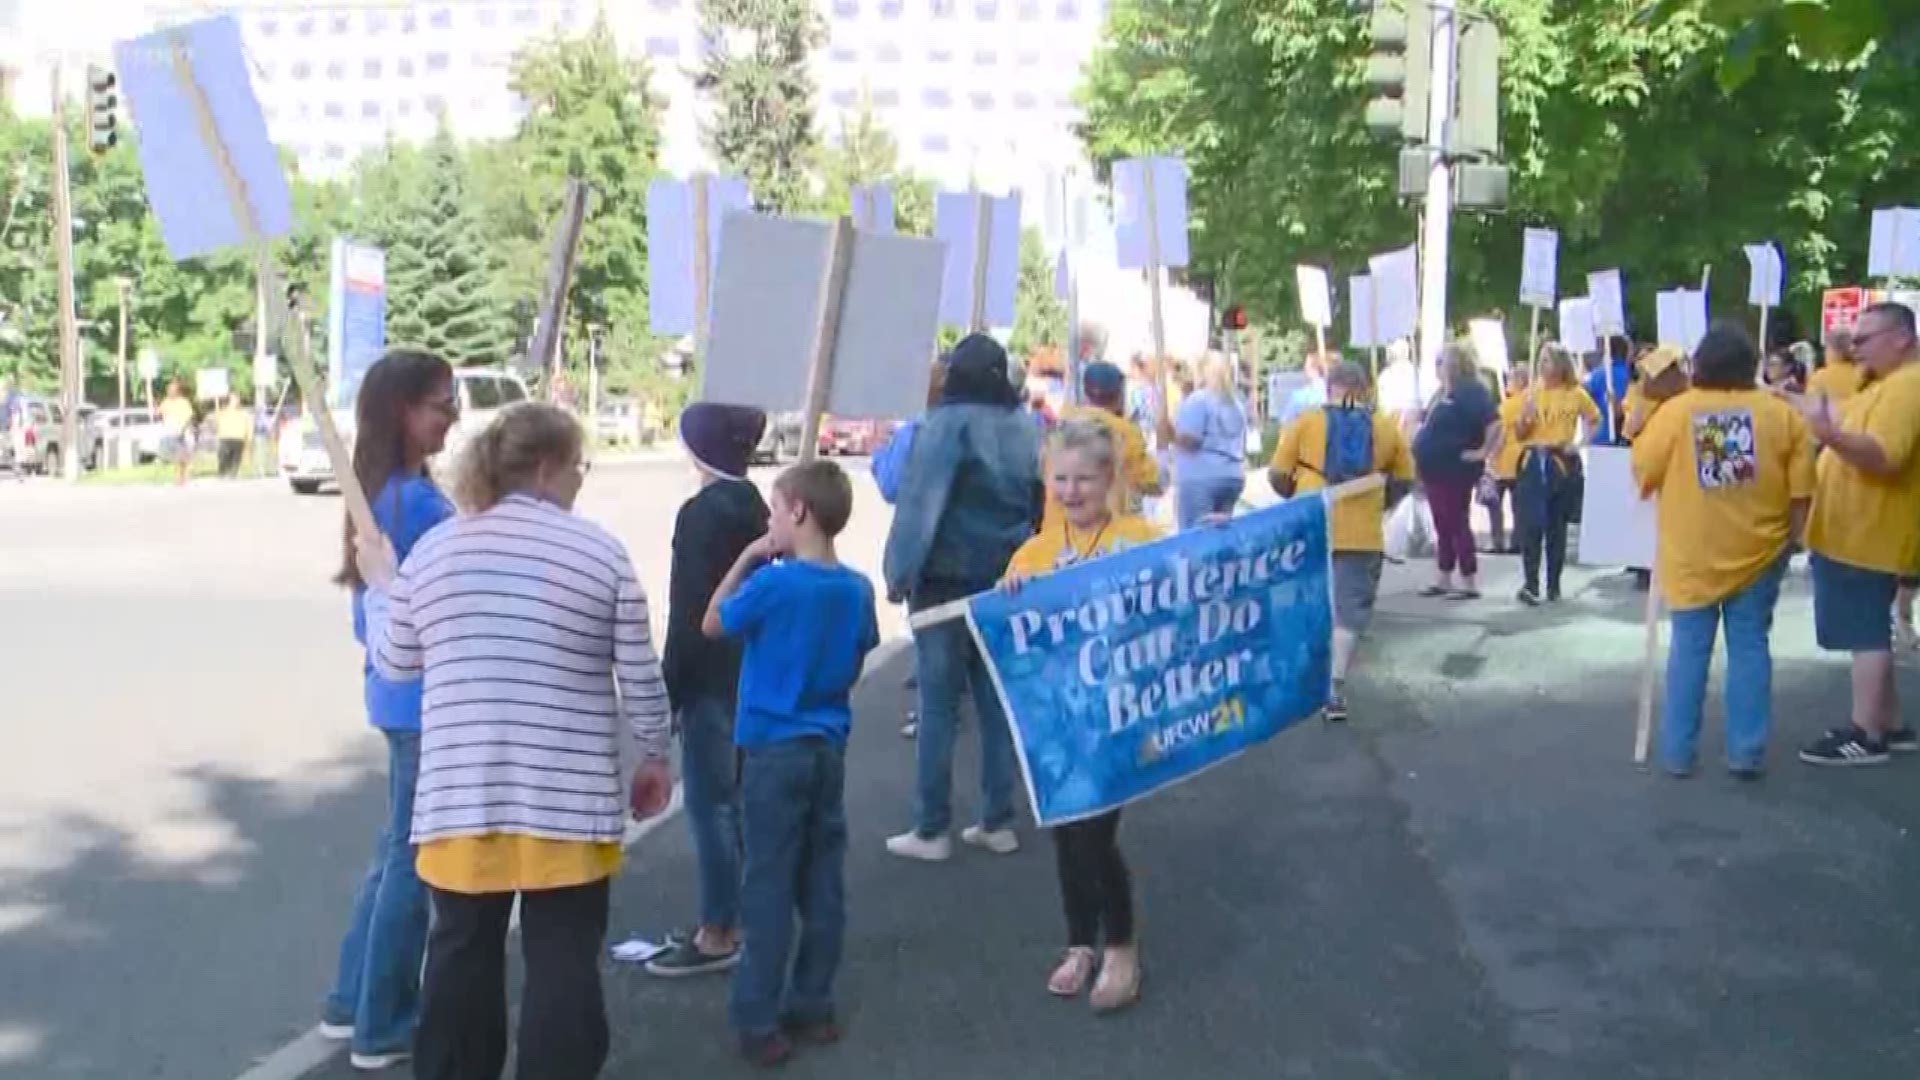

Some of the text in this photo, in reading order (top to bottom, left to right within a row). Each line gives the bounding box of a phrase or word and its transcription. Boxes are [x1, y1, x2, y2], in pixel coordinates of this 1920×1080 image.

[1009, 537, 1305, 654] Providence
[1079, 600, 1261, 686] Can Do
[1109, 649, 1252, 733] Better
